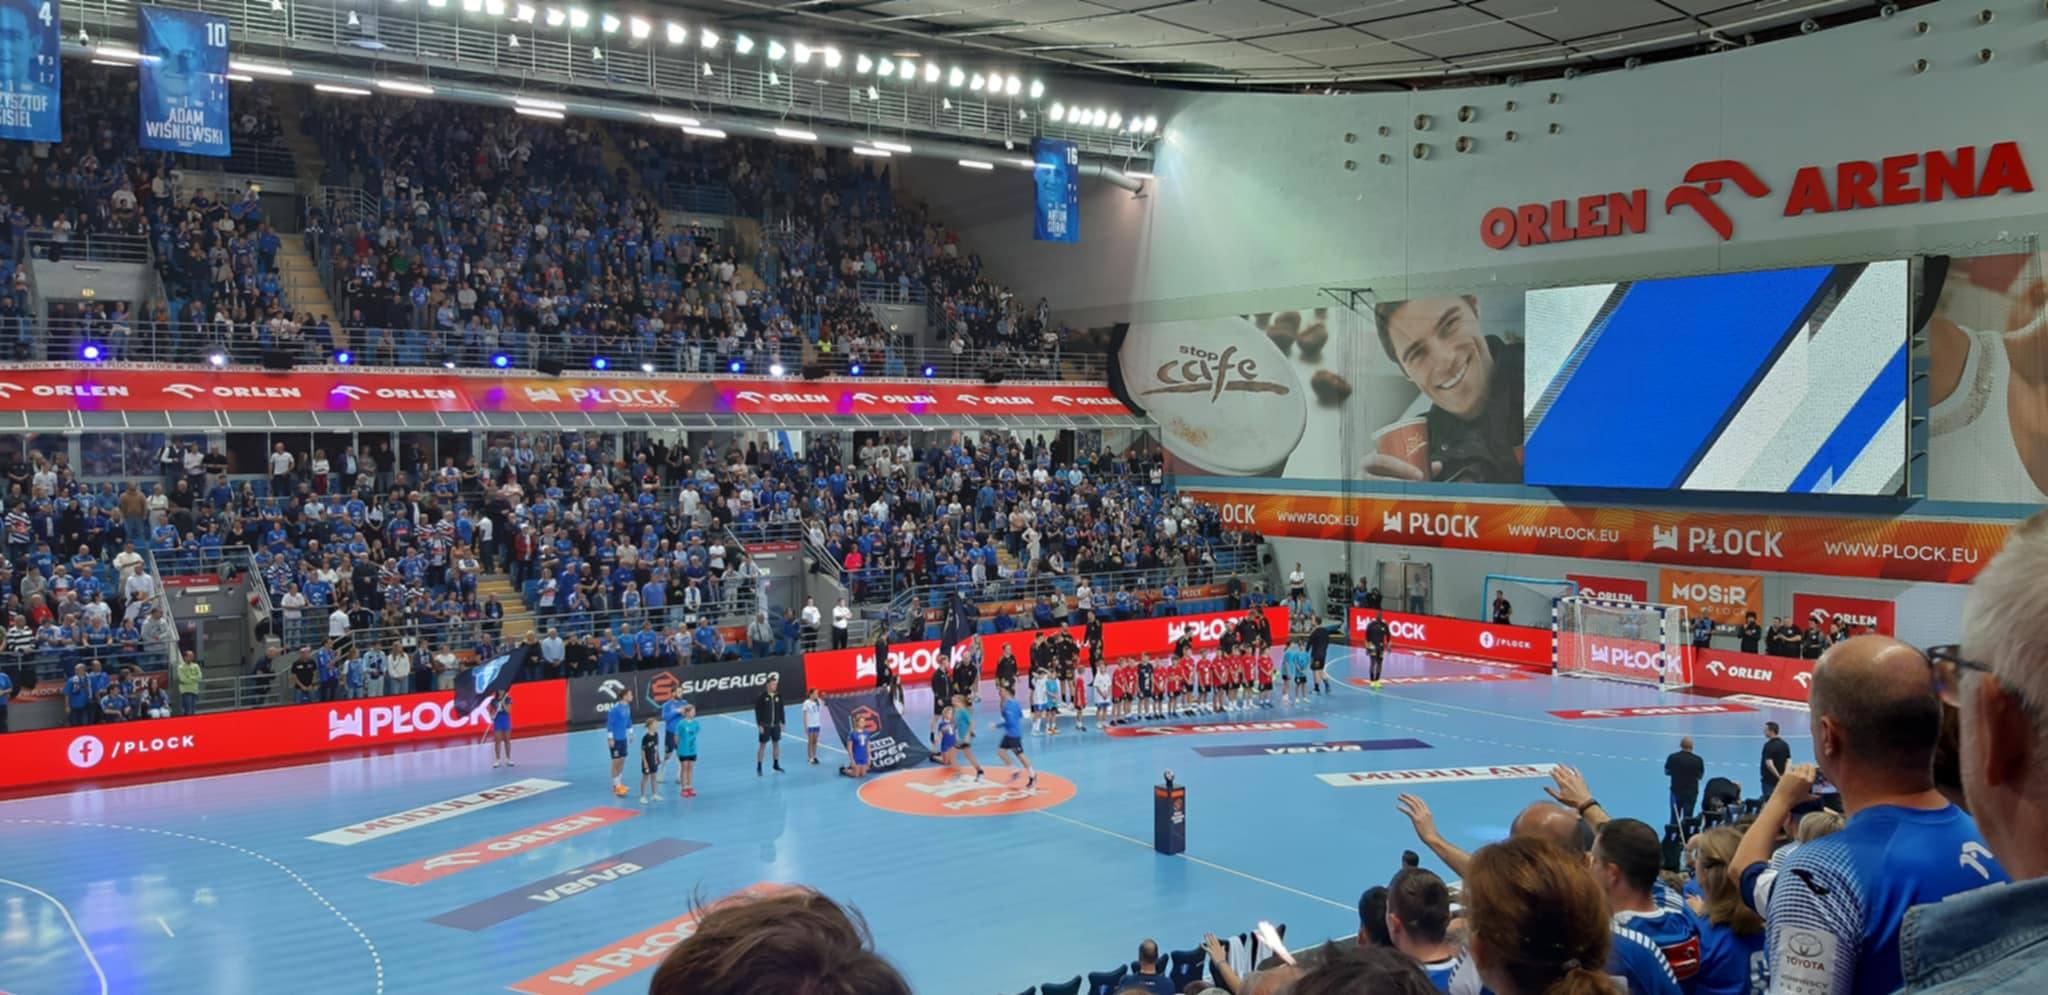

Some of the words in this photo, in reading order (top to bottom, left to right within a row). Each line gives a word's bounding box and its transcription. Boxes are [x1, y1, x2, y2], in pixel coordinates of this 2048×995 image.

[38, 2, 52, 27] 4
[205, 22, 226, 47] 10
[0, 109, 32, 128] ISIEL
[167, 107, 204, 126] ADAM
[1067, 147, 1078, 165] 16
[1480, 188, 1648, 250] ORLEN
[1783, 140, 2034, 217] ARENA
[1178, 344, 1218, 362] stop
[1156, 346, 1259, 403] cafe
[32, 385, 129, 397] ORLEN
[212, 387, 302, 398] ORLEN
[375, 388, 457, 399] ORLEN
[567, 387, 679, 404] PŁOCK
[769, 393, 830, 403] ORLEN
[882, 395, 938, 405] ORLEN
[1219, 503, 1256, 525] OCK
[1276, 510, 1359, 528] WWW.PLOCK.EU
[1409, 512, 1479, 539] PŁOCK
[1508, 523, 1619, 544] WWW.PLOCK.EU
[1687, 526, 1784, 558] PŁOCK
[1824, 540, 1979, 564] WWW.PLOCK.EU
[1833, 612, 1877, 627] ORLEN
[1383, 620, 1426, 641] OCK
[1611, 648, 1682, 675] PŁOCK
[1727, 665, 1773, 682] ORLEN
[369, 695, 496, 737] PŁOCK
[1191, 722, 1296, 732] ORLEN
[1264, 745, 1362, 755] verva
[344, 785, 525, 835] MODULAR
[487, 815, 605, 852] ORLEN
[528, 861, 643, 903] verva
[595, 916, 703, 968] PŁOC
[1786, 955, 1825, 971] TOYOTA
